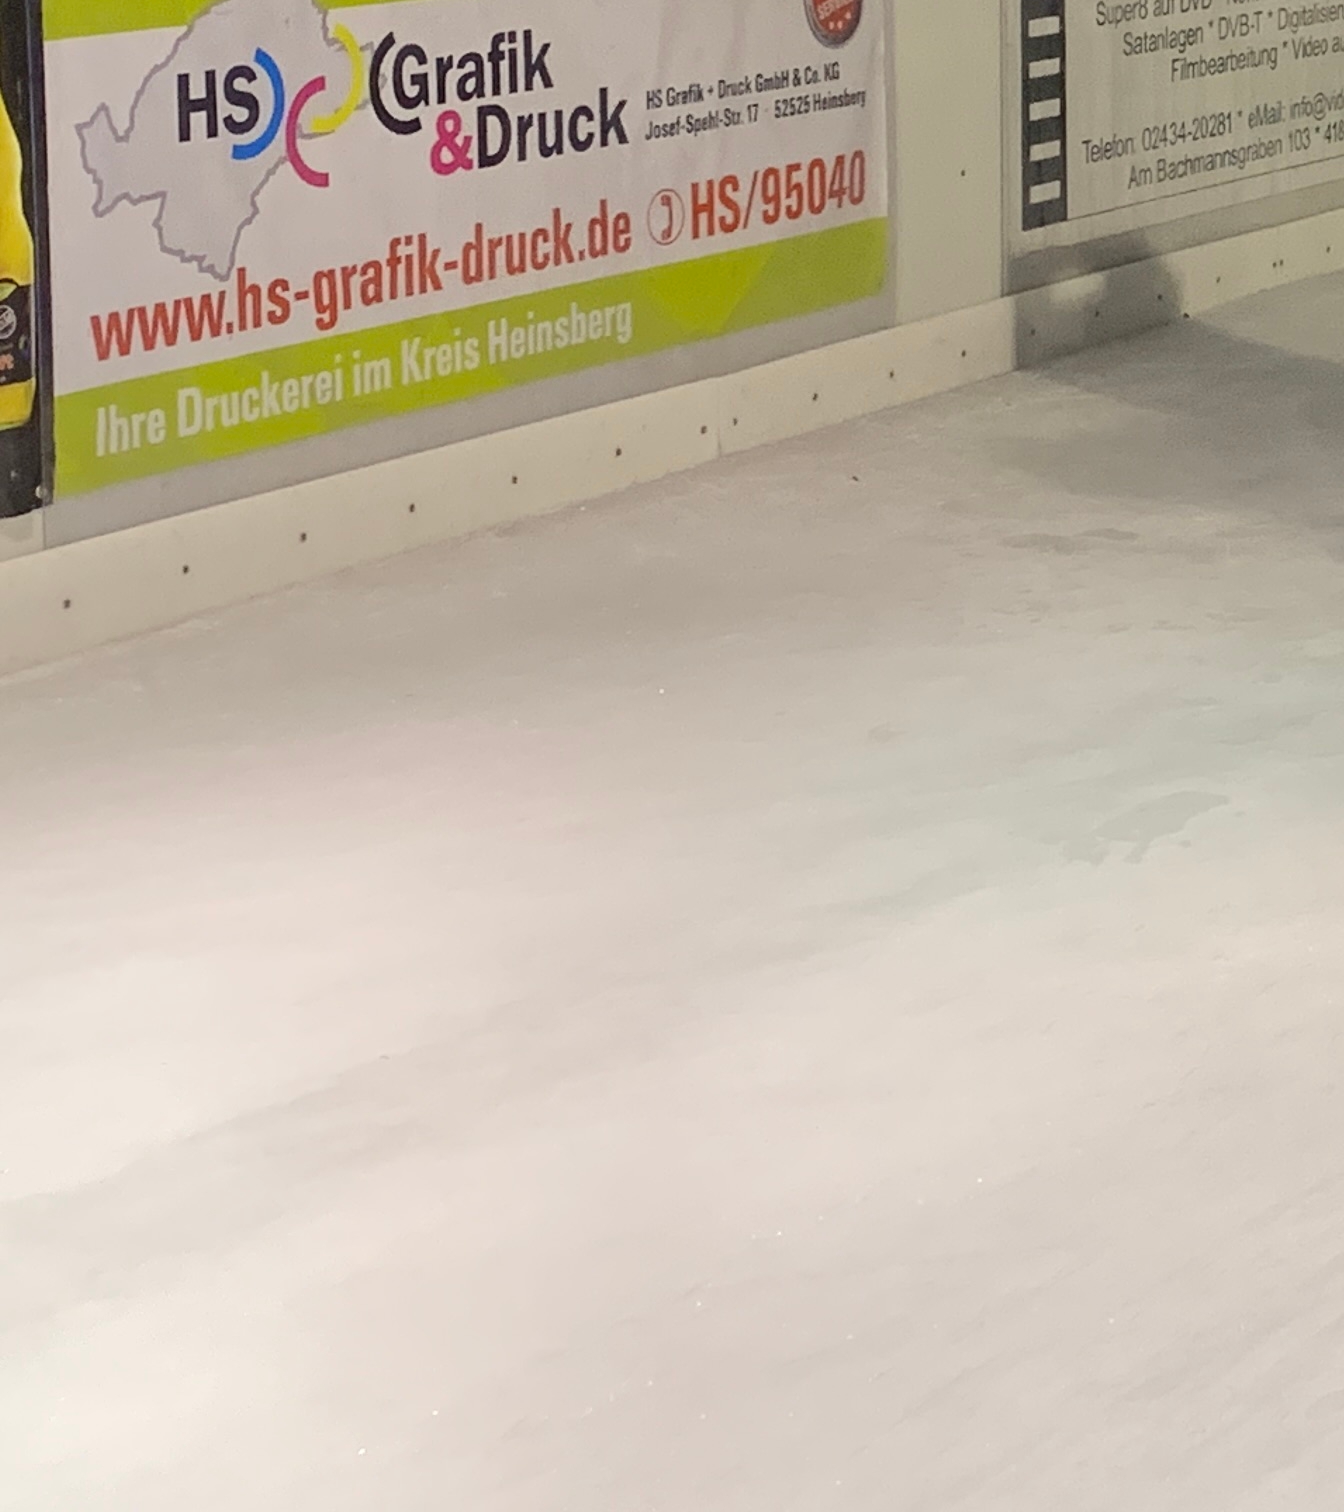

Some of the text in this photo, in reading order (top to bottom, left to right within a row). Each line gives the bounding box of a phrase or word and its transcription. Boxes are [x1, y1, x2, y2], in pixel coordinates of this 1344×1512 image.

[1123, 26, 1204, 57] Satanlagen
[1218, 12, 1263, 41] DVB-T
[1170, 44, 1279, 83] Filmbearbeitung
[1291, 34, 1329, 61] Video
[392, 29, 553, 111] Grafik
[646, 90, 662, 110] HS
[666, 83, 704, 106] Grafik
[718, 76, 752, 99] Druck
[755, 70, 789, 93] GmbH
[792, 69, 801, 87] &
[824, 61, 840, 81] KG
[176, 66, 260, 143] HS
[746, 103, 760, 123] 17
[774, 94, 811, 119] 52525
[813, 89, 867, 113] Heinsberg
[1141, 110, 1234, 153] 02434-20281
[1128, 164, 1153, 189] Am
[1156, 137, 1284, 184] Bachmannsgraben
[90, 150, 867, 362] www.hs-grafik-druck.de HS/95040
[95, 299, 633, 458] Ihre Druckerei im Kreis Heinsberg
